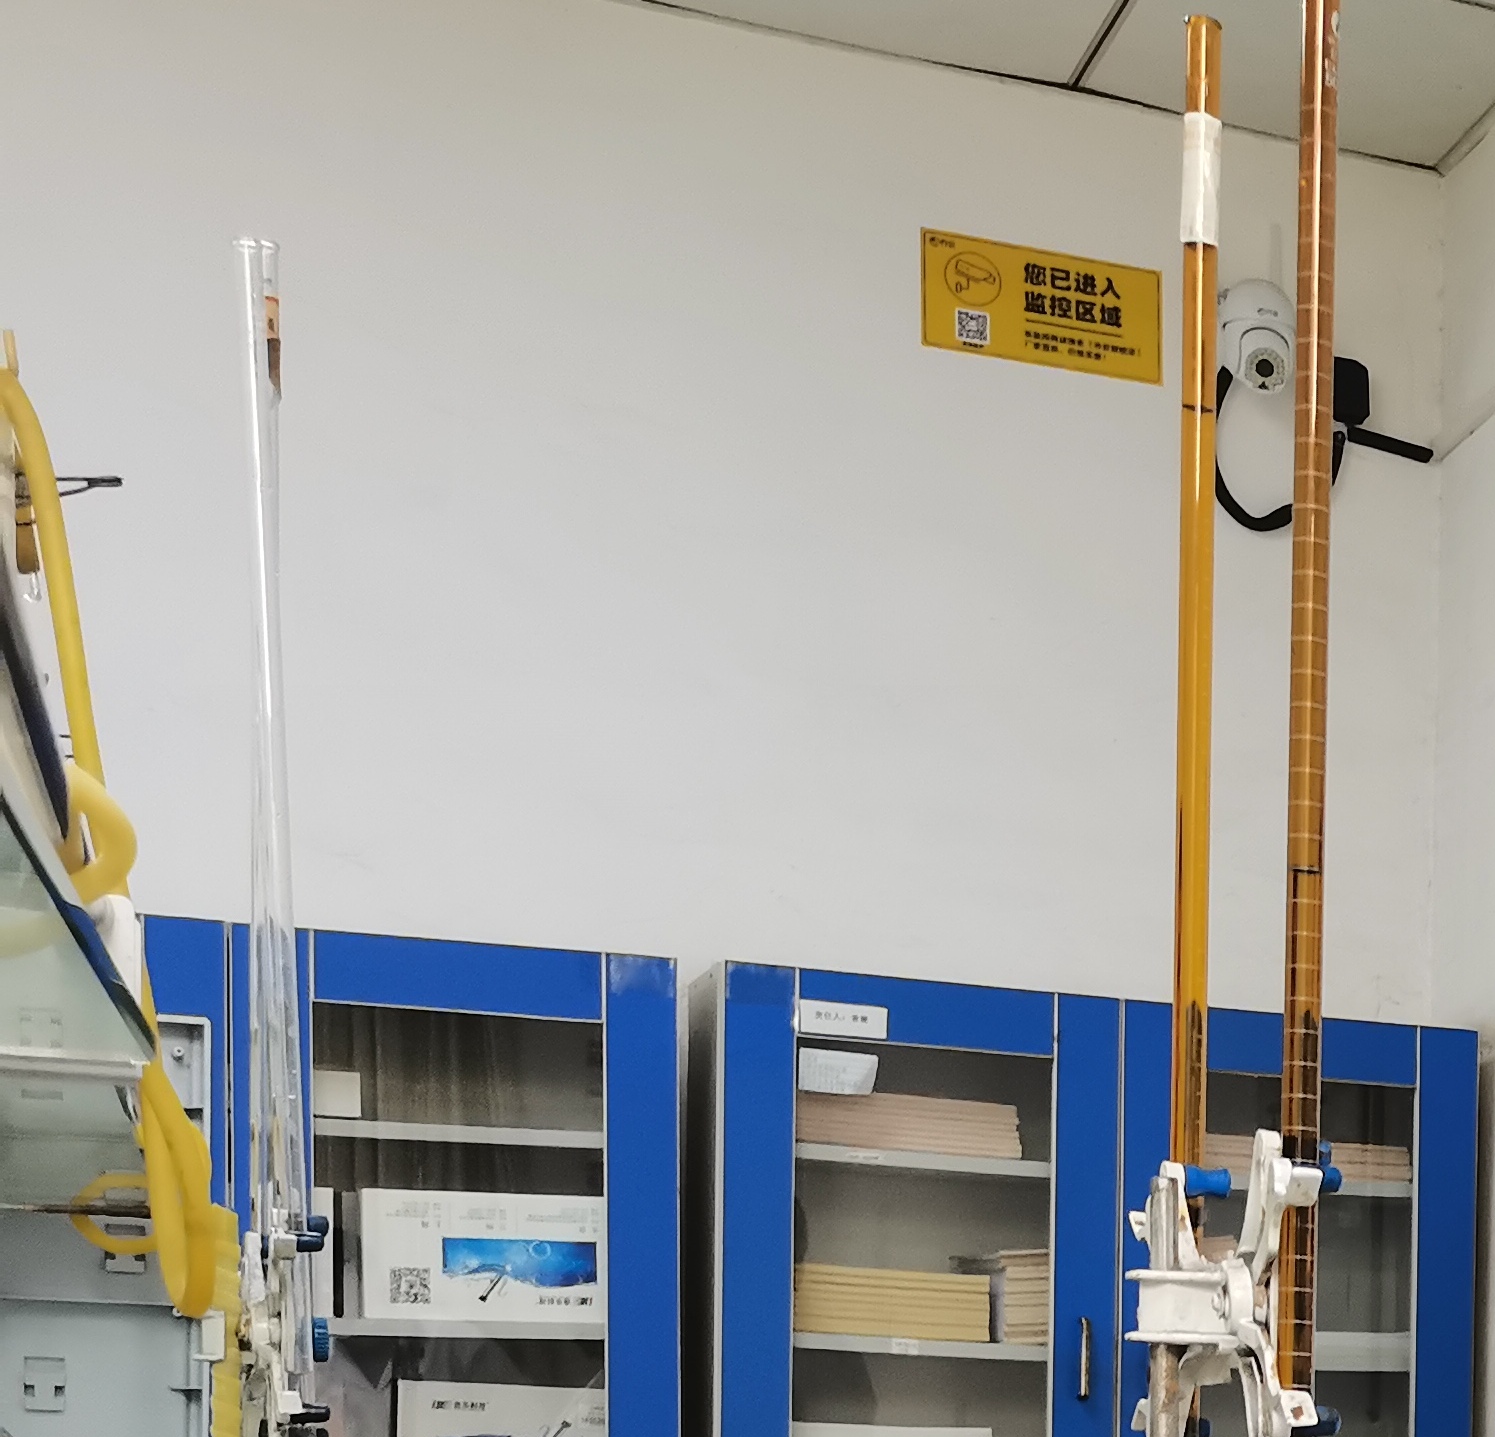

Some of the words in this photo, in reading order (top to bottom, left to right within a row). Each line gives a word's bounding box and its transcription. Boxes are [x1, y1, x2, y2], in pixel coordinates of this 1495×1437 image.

[1023, 261, 1121, 300] 您已进入
[1023, 290, 1123, 328] 监控区域
